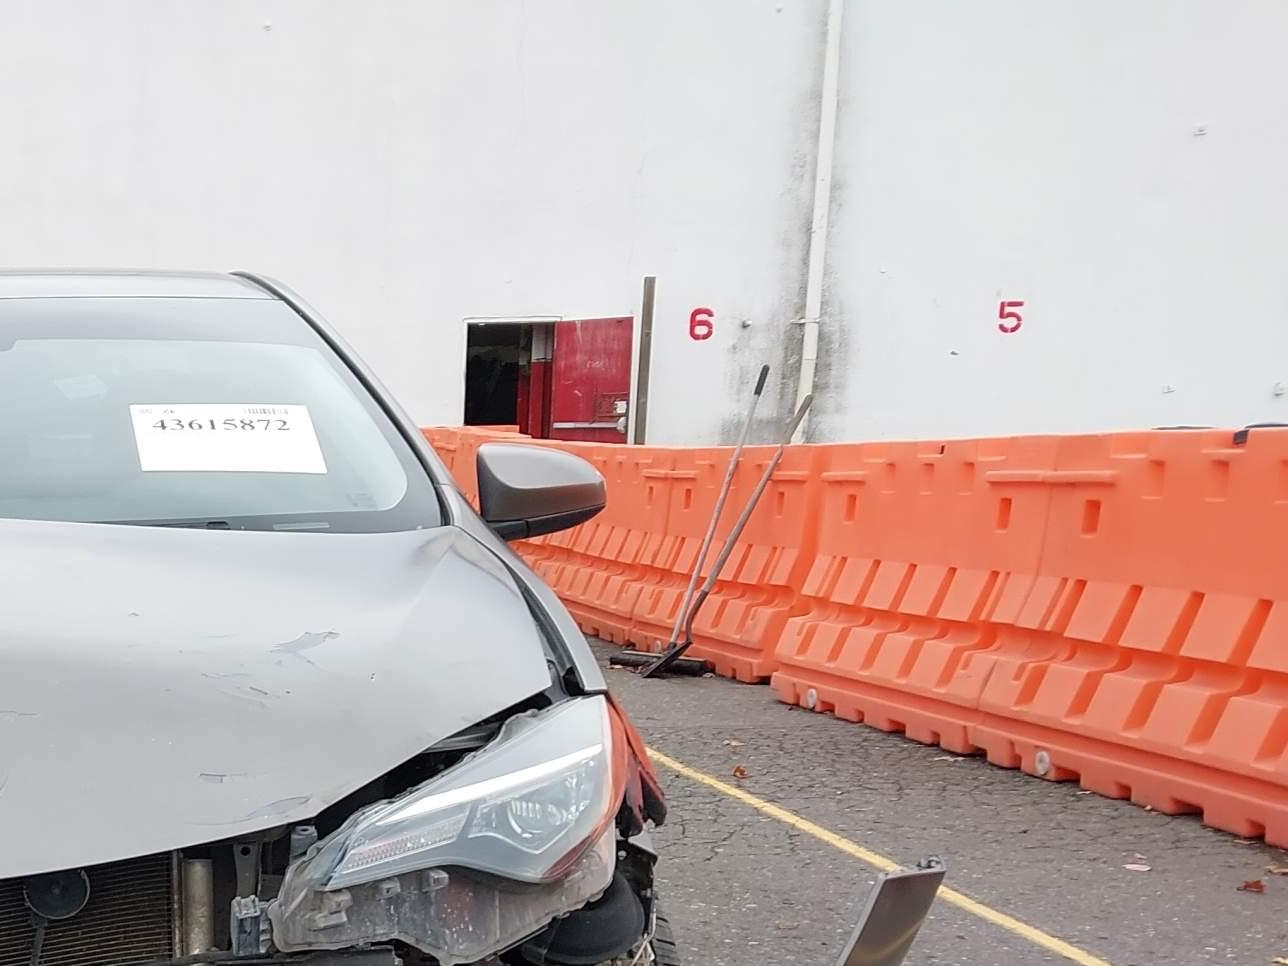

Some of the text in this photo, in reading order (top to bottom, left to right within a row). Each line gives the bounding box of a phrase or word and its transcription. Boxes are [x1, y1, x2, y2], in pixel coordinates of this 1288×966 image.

[689, 308, 713, 341] 6
[998, 301, 1023, 333] 5
[152, 418, 291, 432] 43615872
